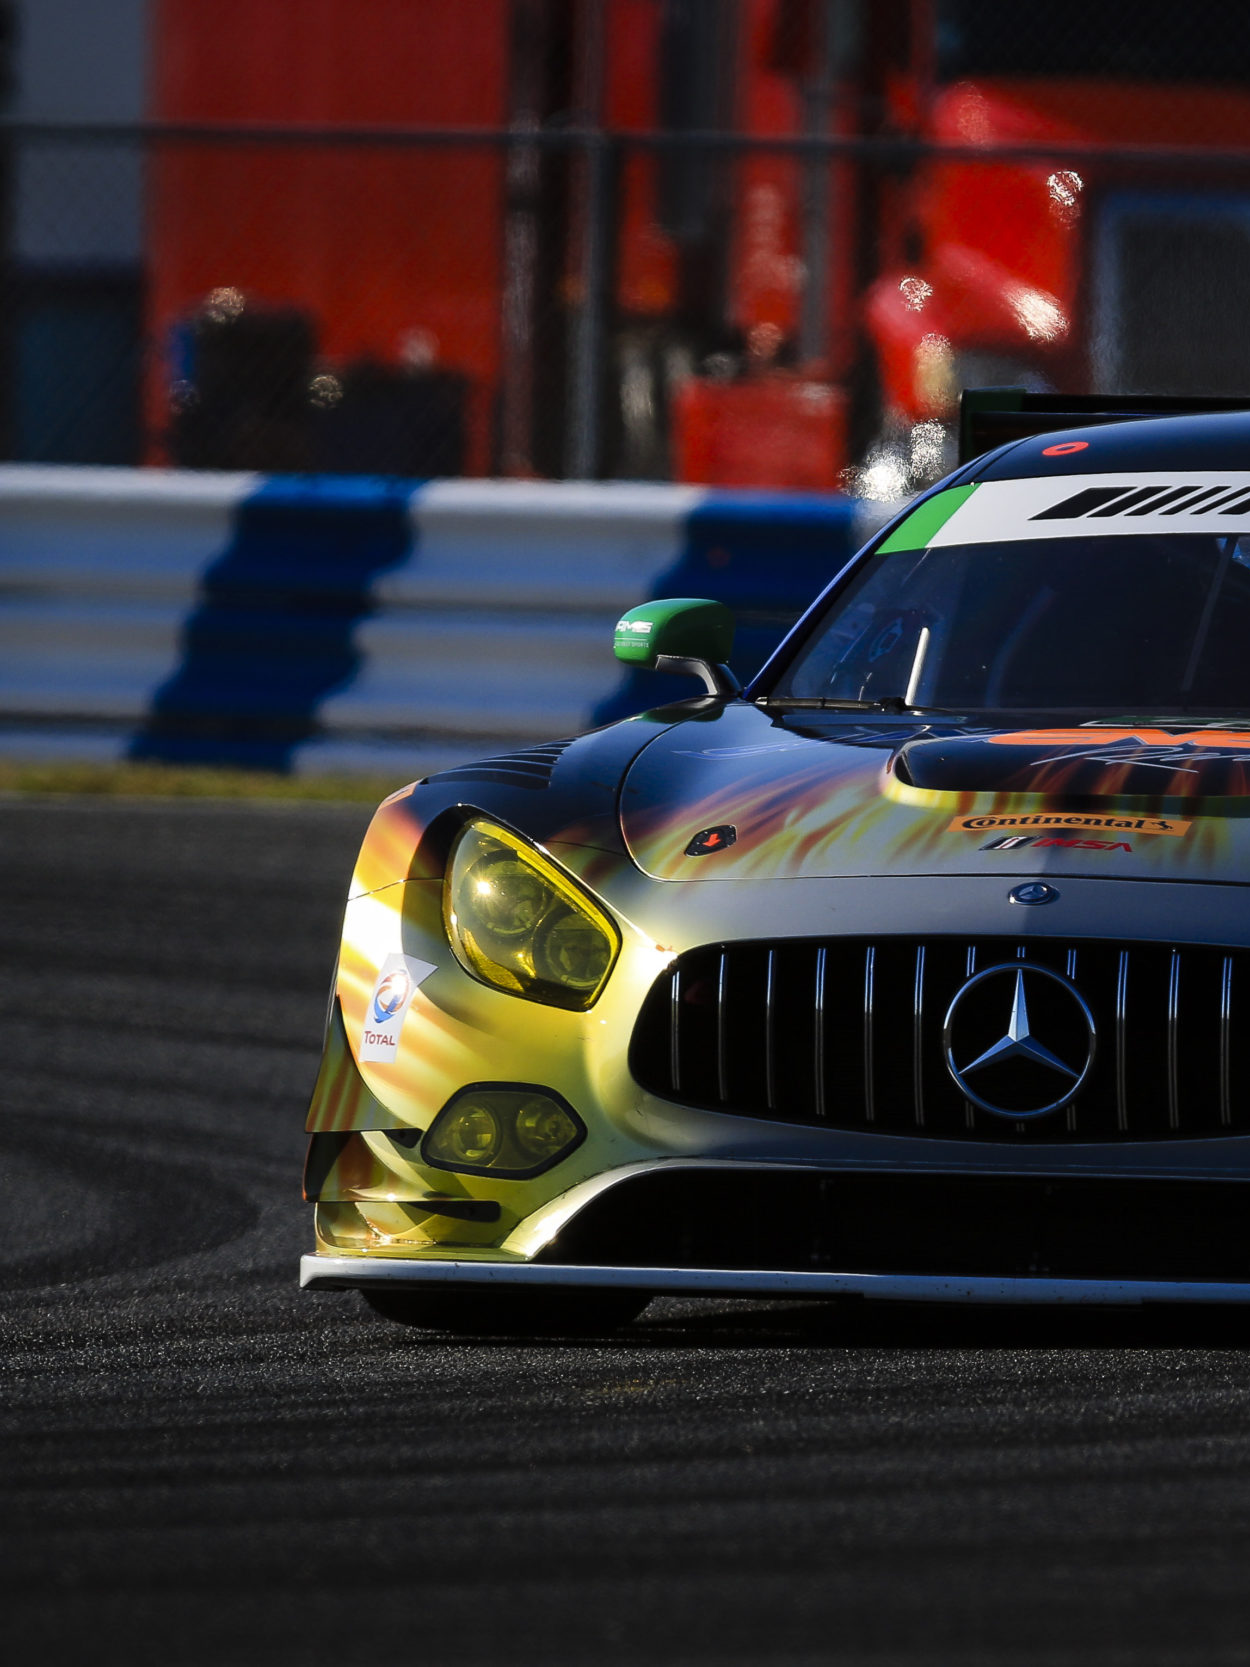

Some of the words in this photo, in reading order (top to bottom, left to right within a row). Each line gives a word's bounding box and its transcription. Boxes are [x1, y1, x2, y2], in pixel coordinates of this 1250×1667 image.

[962, 815, 1144, 829] Continental
[1031, 837, 1132, 852] IMSA
[364, 1031, 396, 1046] TOTAL
